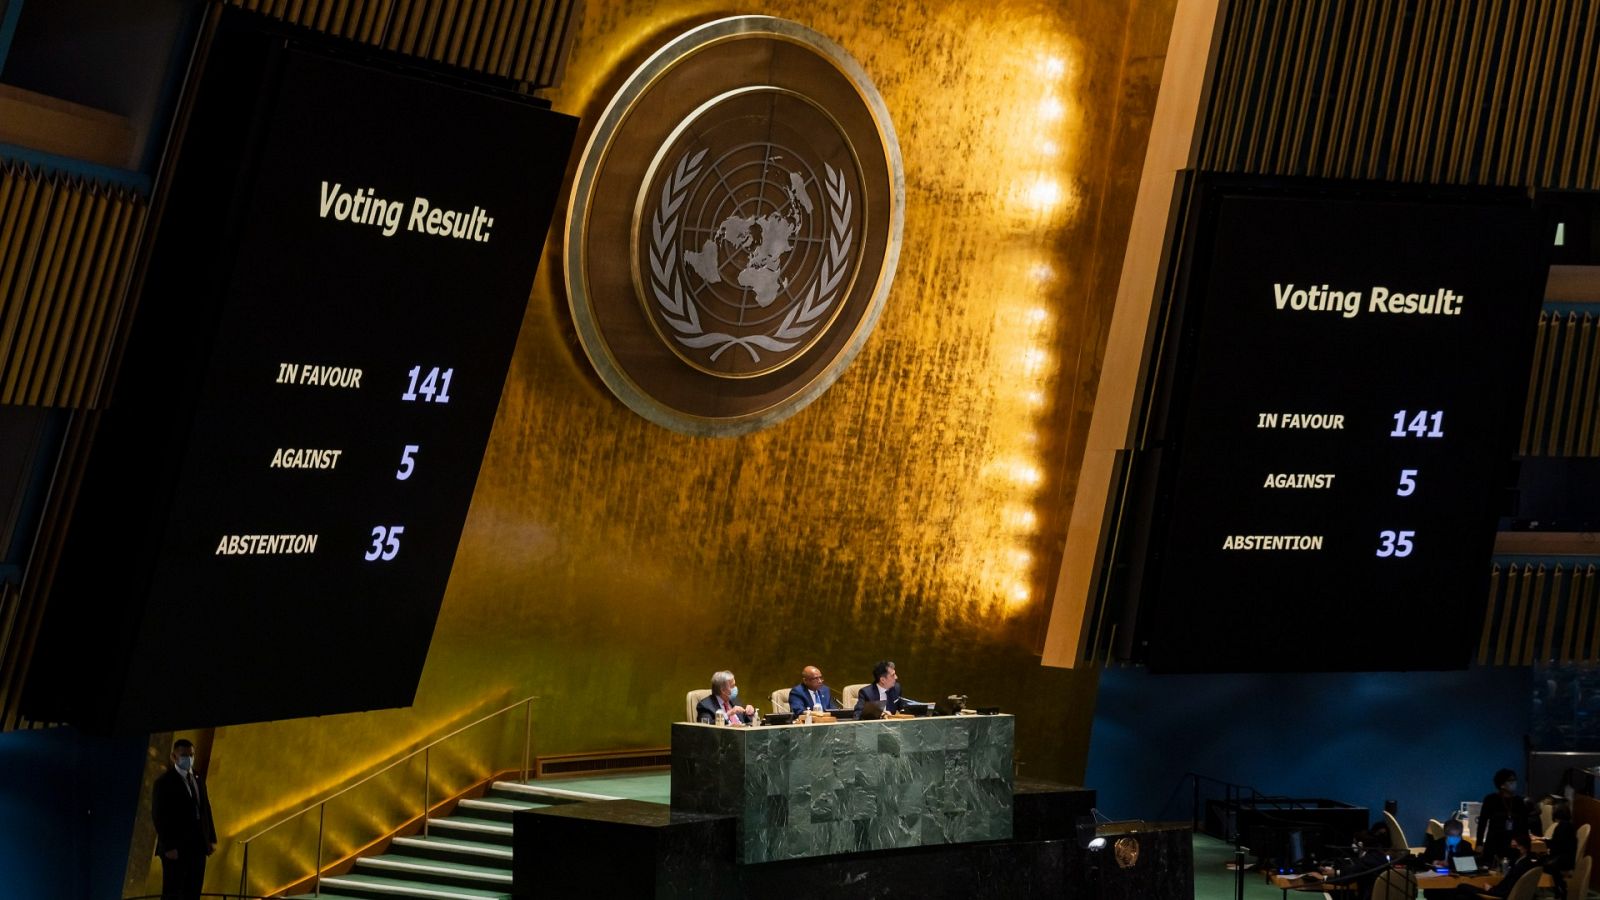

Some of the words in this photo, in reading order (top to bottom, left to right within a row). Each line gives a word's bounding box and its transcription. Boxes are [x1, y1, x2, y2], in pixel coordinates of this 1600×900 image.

[320, 181, 403, 236] Voting
[408, 197, 493, 242] Result:
[1274, 284, 1361, 318] Voting
[1369, 287, 1463, 314] Result:
[276, 363, 298, 383] IN
[300, 365, 362, 388] FAVOUR
[402, 366, 453, 403] 141
[1257, 413, 1278, 428] IN
[1281, 414, 1344, 429] FAVOUR
[1391, 410, 1443, 437] 141
[270, 448, 342, 469] AGAINST
[396, 445, 419, 480] 5
[1264, 474, 1335, 488] AGAINST
[1397, 470, 1417, 496] 5
[216, 535, 318, 554] ABSTENTION
[365, 526, 404, 561] 35
[1223, 536, 1323, 549] ABSTENTION
[1376, 530, 1415, 557] 35
